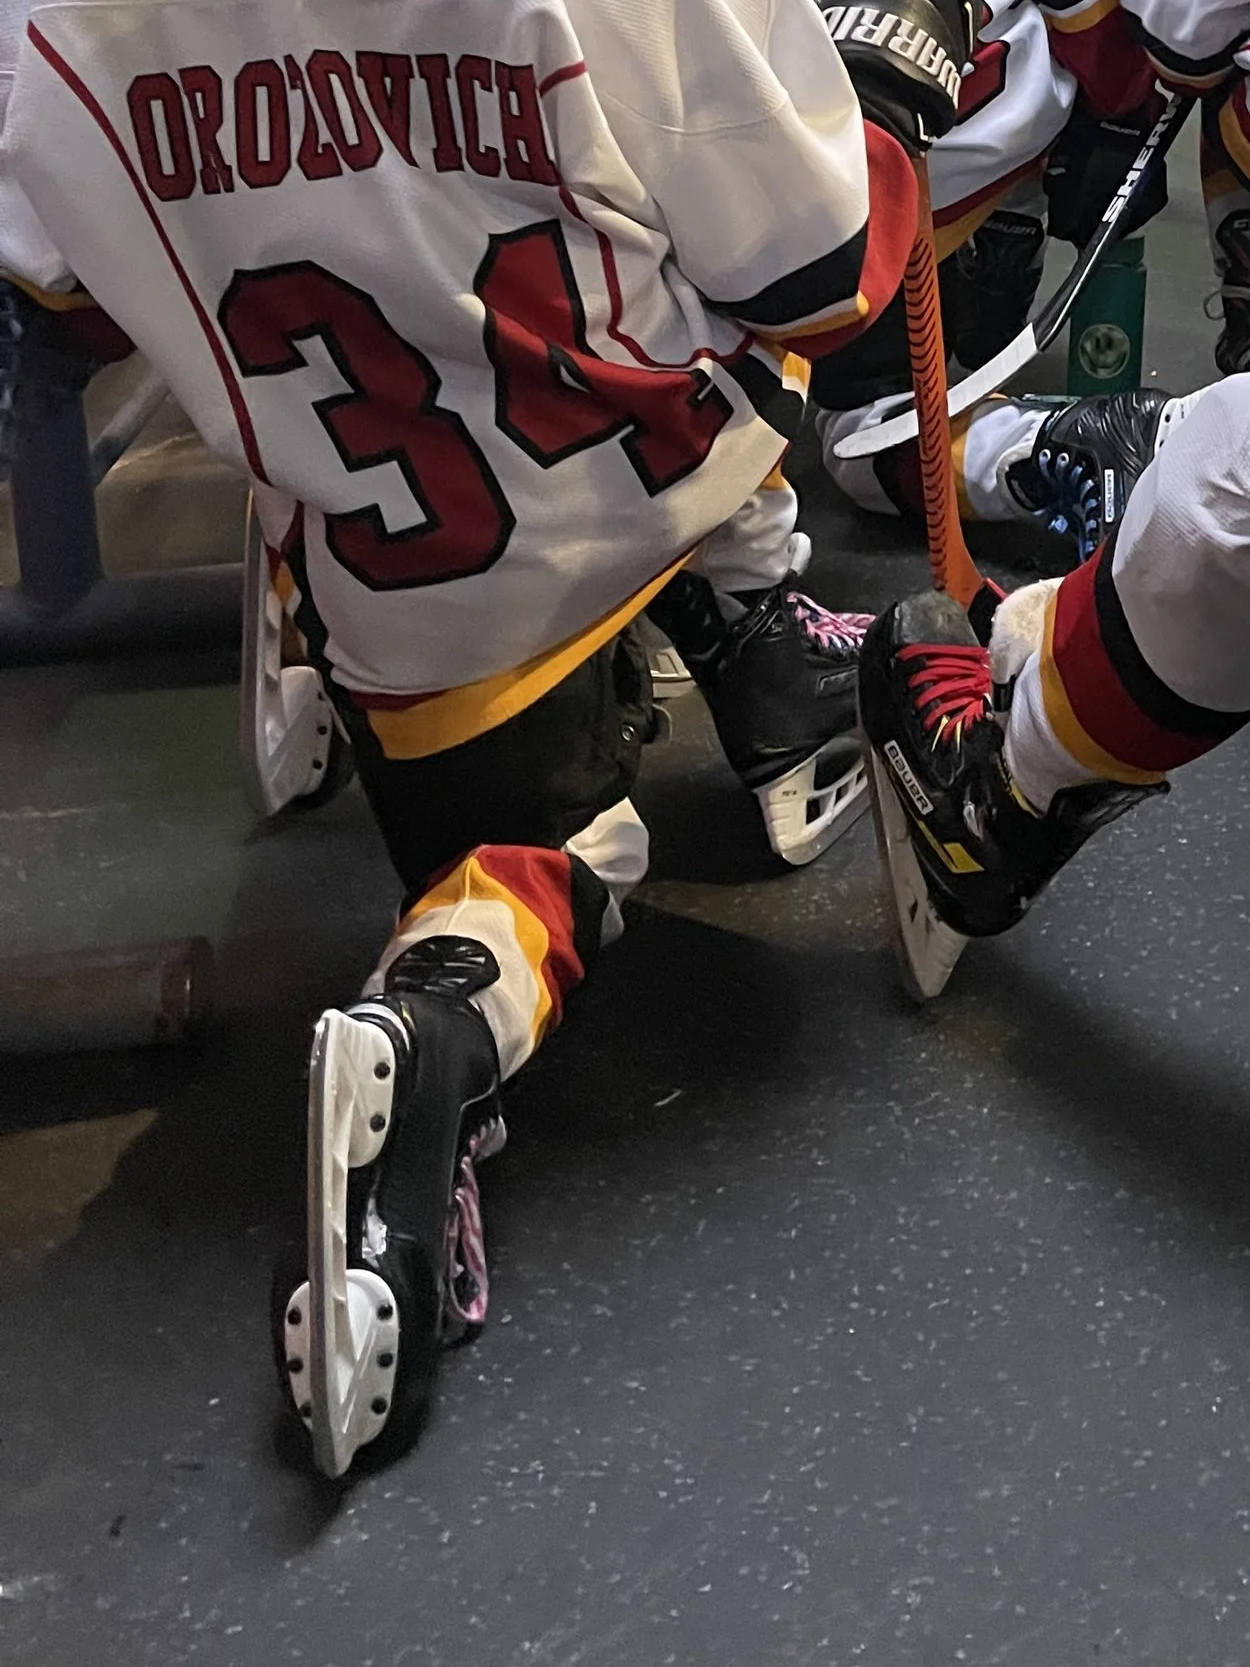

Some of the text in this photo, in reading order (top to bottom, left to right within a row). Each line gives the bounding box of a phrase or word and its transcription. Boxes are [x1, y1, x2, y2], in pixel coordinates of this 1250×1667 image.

[126, 49, 562, 202] OROZOVICH
[217, 218, 734, 592] 34
[887, 744, 929, 811] BAUER
